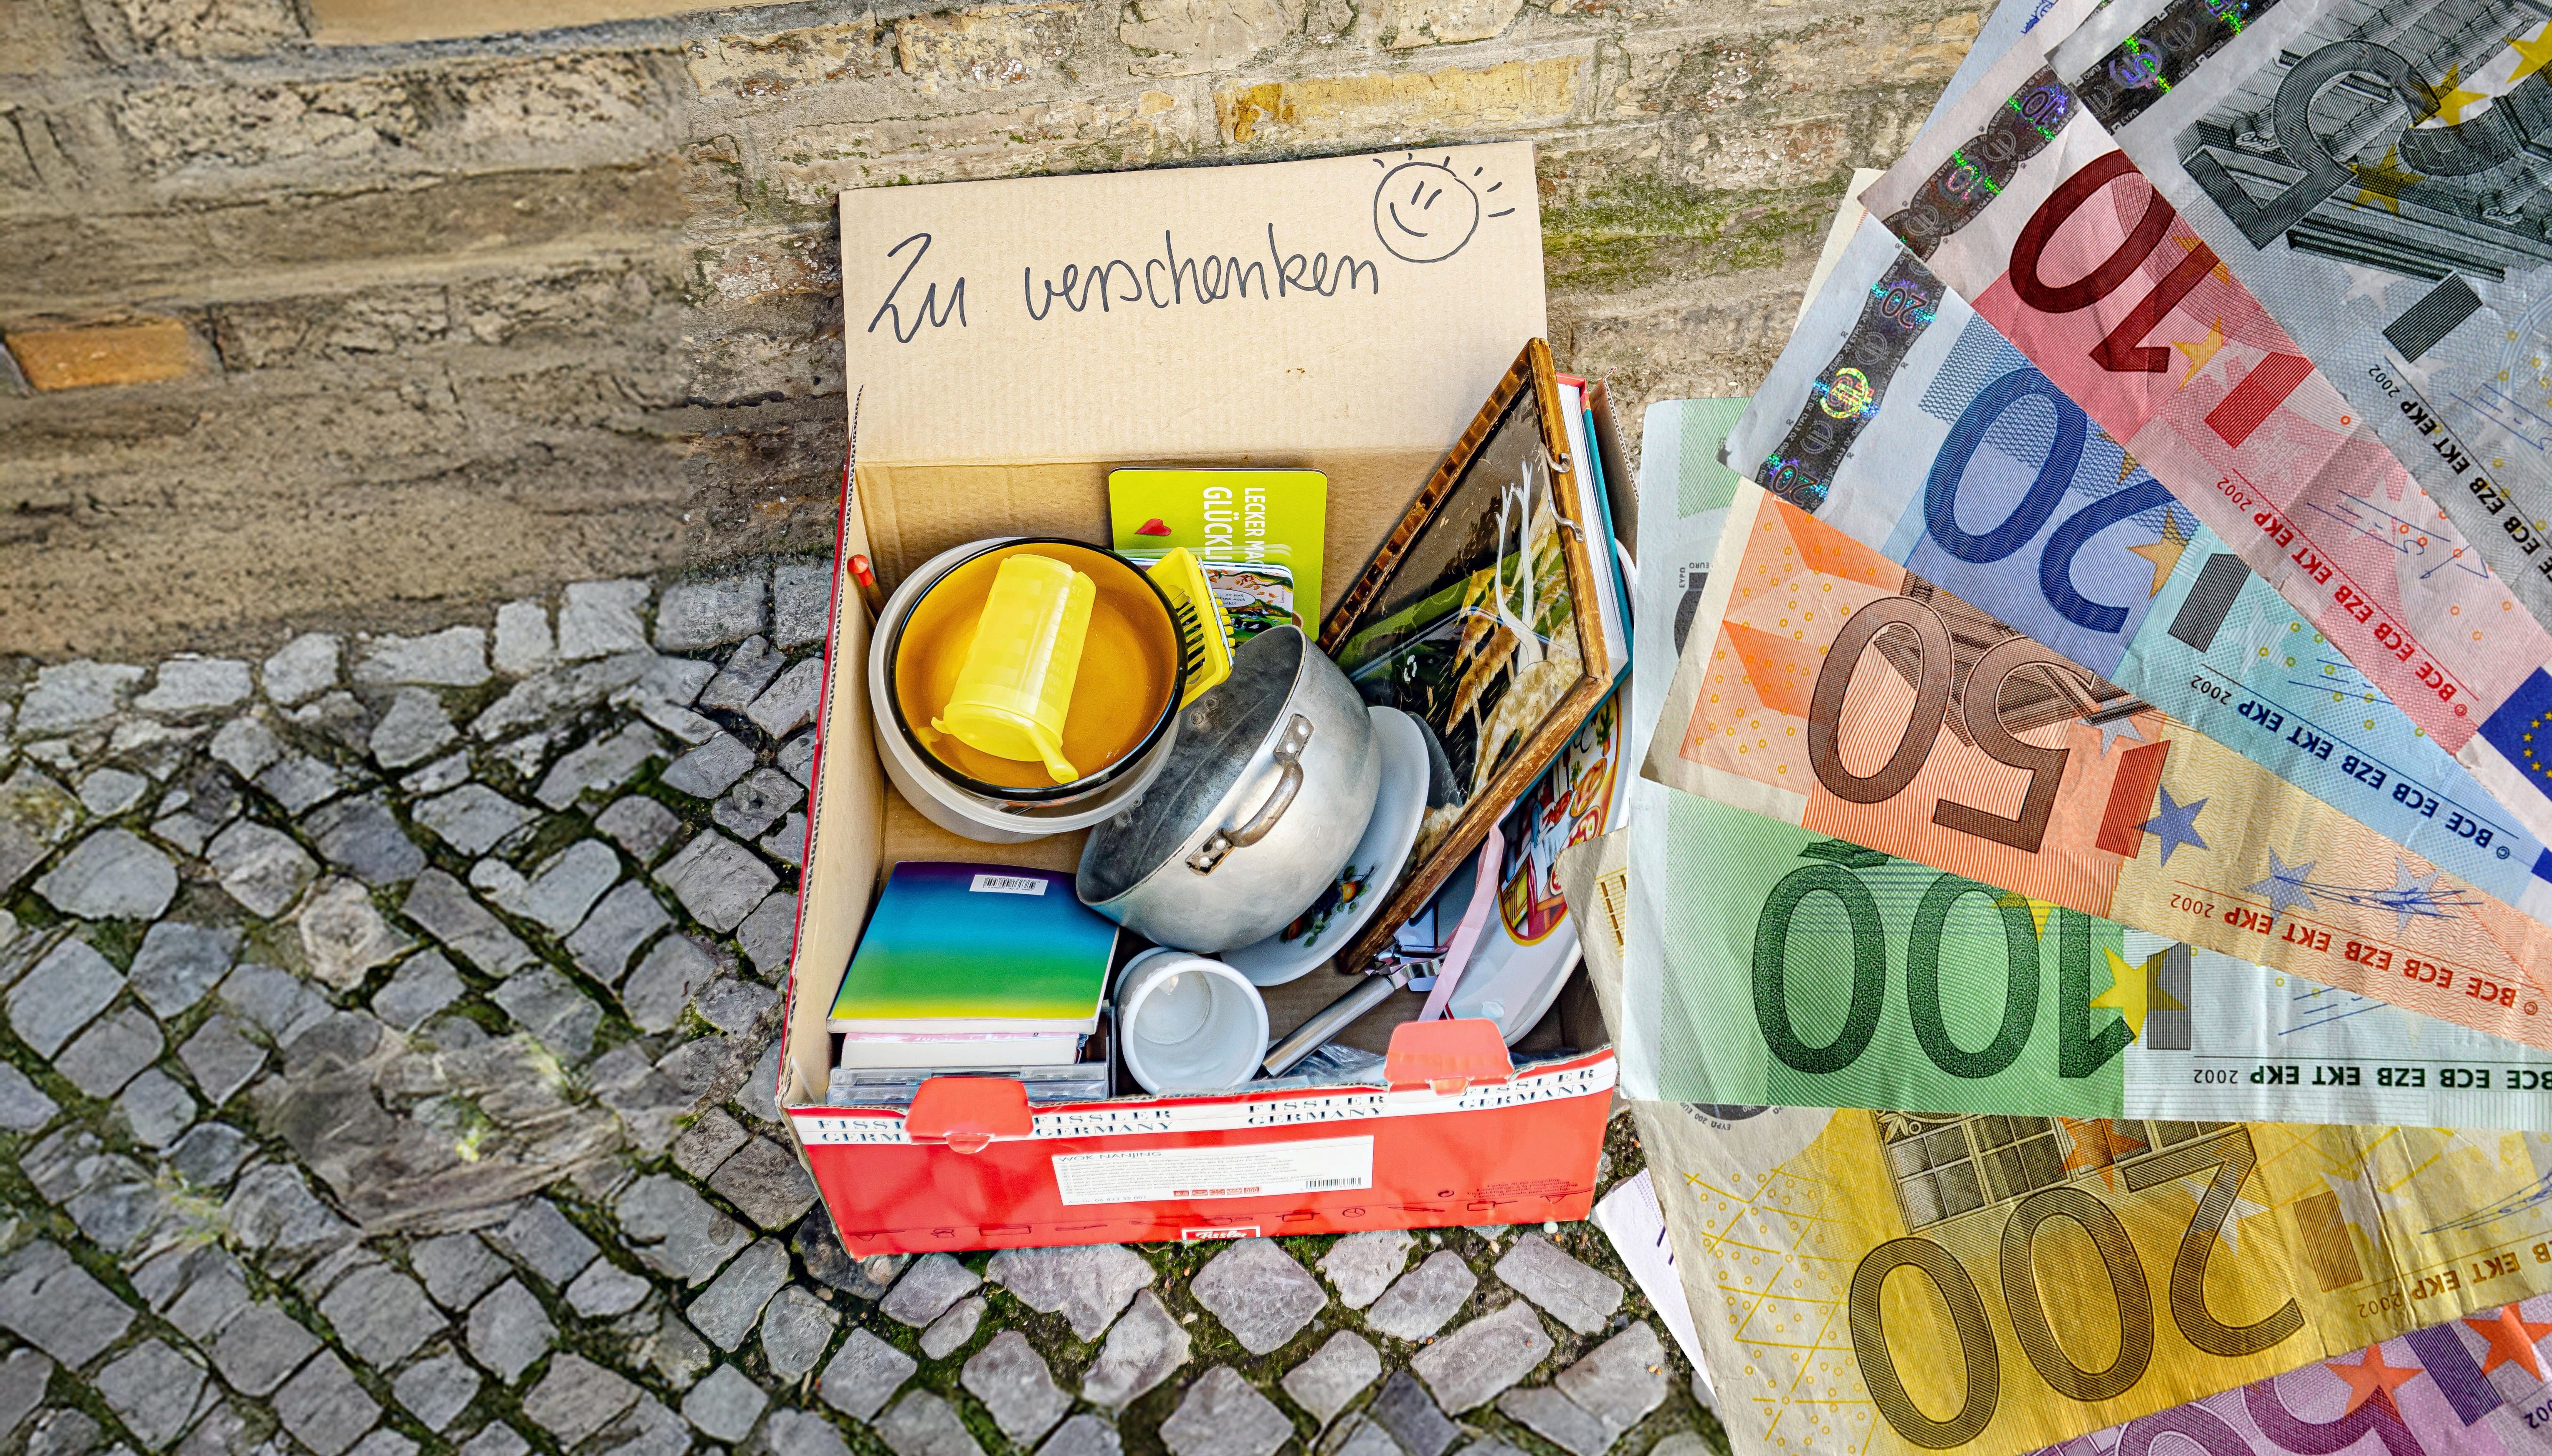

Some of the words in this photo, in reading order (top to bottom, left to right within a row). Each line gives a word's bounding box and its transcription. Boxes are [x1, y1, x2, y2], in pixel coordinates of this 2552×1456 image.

[2183, 38, 2442, 250] 5
[2009, 148, 2220, 373] 10
[867, 233, 967, 344] Zu
[1024, 222, 1380, 321] verschenken
[2368, 364, 2400, 398] 2002
[2400, 400, 2437, 436] EKP
[2432, 437, 2471, 475] EKT
[1924, 367, 2178, 634] 20
[2217, 477, 2252, 512] 2002
[2469, 477, 2506, 516] EZB
[1244, 488, 1266, 537] LECKER
[2253, 511, 2294, 549] EKP
[2504, 516, 2541, 556] ECB
[2291, 547, 2334, 584] EKT
[2333, 584, 2375, 624] EZB
[2373, 622, 2416, 662] ECB
[2190, 675, 2233, 706] 2002
[2415, 660, 2458, 702] BCE
[1808, 597, 2097, 854] 50
[2237, 700, 2284, 733] EKP
[2286, 726, 2334, 761] EKT
[2341, 754, 2388, 790] EZB
[2392, 782, 2439, 818] ECB
[2444, 811, 2494, 849] BCE
[2170, 892, 2215, 919] 2002
[2224, 906, 2275, 936] EKP
[2281, 923, 2332, 953] EKT
[1752, 864, 2137, 1079] 100
[2344, 940, 2393, 972] EZB
[2403, 956, 2454, 990] ECB
[2466, 977, 2517, 1009] BCE
[2193, 1068, 2238, 1085] 2002
[2249, 1065, 2299, 1085] EKP
[2311, 1065, 2361, 1085] EKT
[2377, 1068, 2425, 1087] EZB
[2440, 1068, 2490, 1088] ECB
[2506, 1069, 2552, 1090] BCE
[1033, 1110, 1172, 1126] FISSLER
[1249, 1095, 1385, 1114] FISSLER
[1034, 1122, 1173, 1138] GERMANY
[1248, 1106, 1385, 1125] GERMANY
[1459, 1082, 1595, 1109] GERMANY
[1099, 1150, 1162, 1160] NANJING
[2472, 1252, 2521, 1284] EKT
[1848, 1127, 2305, 1449] 200
[2410, 1271, 2461, 1302] EKP
[2359, 1292, 2402, 1319] 2002
